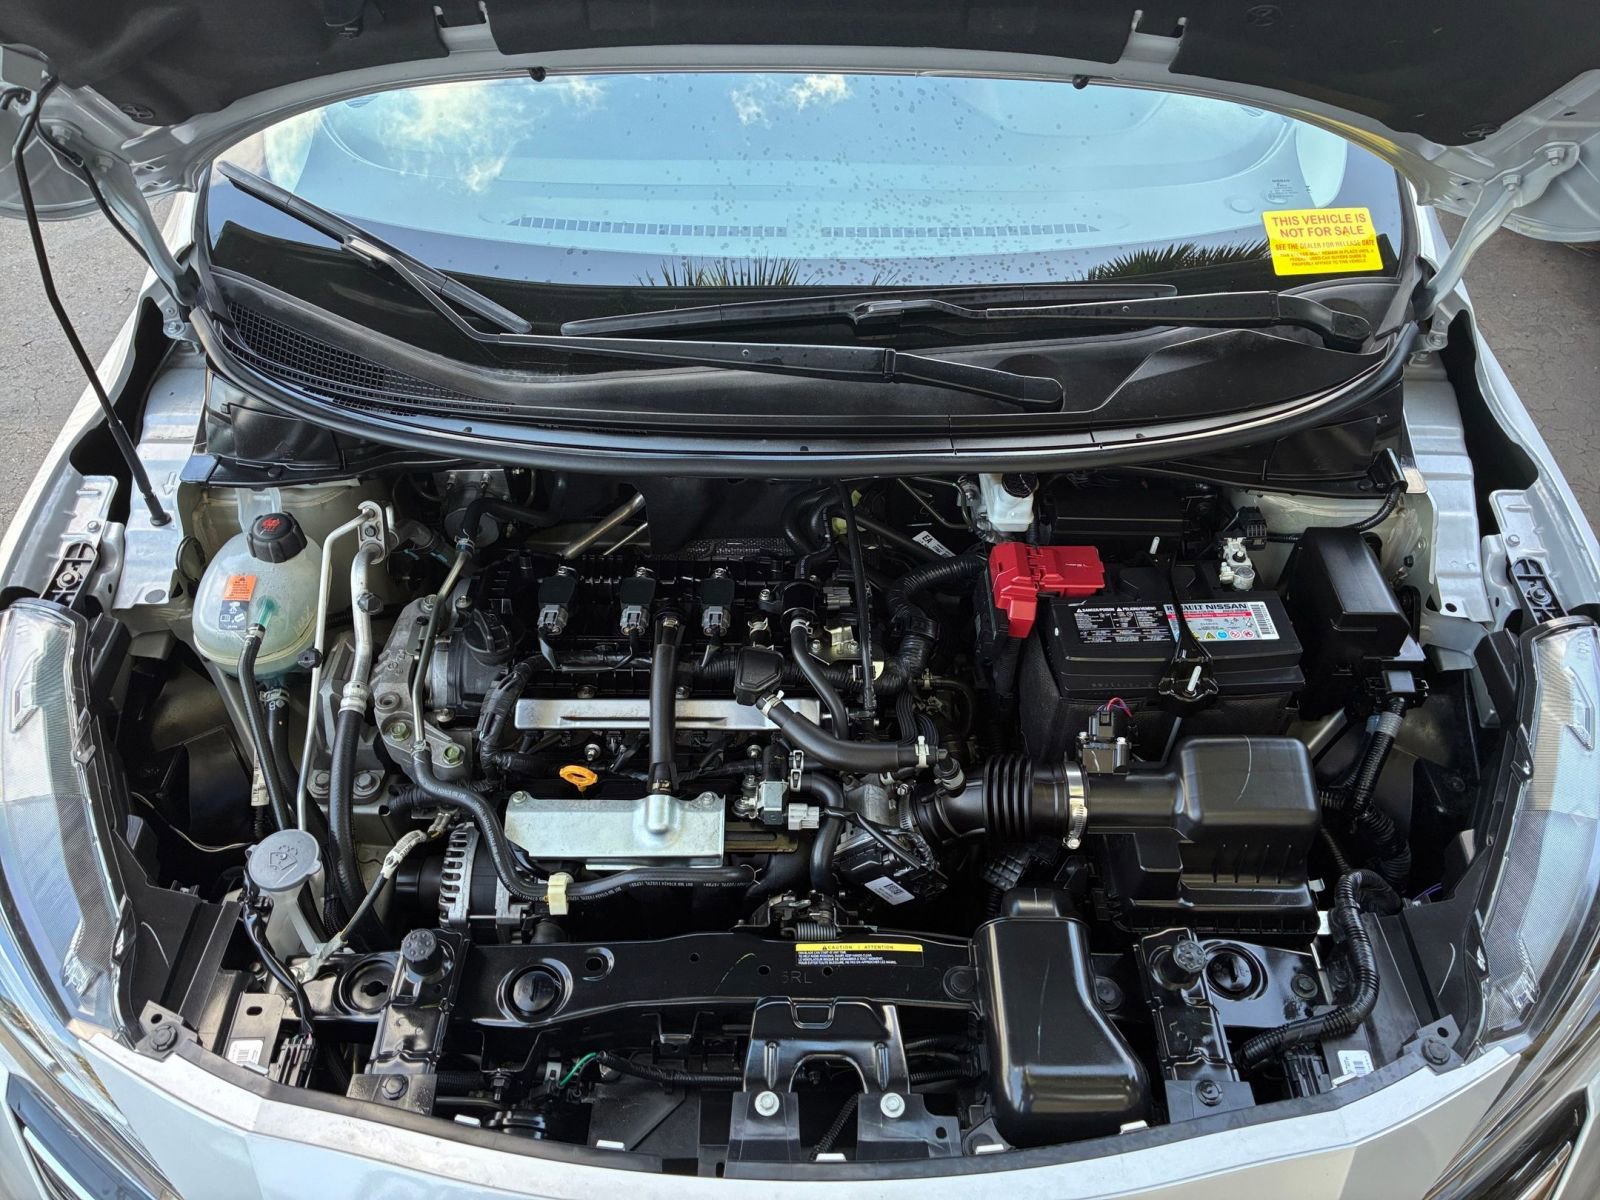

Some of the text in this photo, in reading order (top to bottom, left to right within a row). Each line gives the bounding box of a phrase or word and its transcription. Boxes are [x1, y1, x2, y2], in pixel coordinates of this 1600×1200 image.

[1271, 213, 1366, 226] THIS VEHICLE IS
[1280, 225, 1364, 238] NOT FOR SALE
[1288, 242, 1299, 250] THE
[1300, 241, 1321, 249] DEALER
[1335, 239, 1361, 248] RELEASE
[1166, 603, 1203, 612] RAULT
